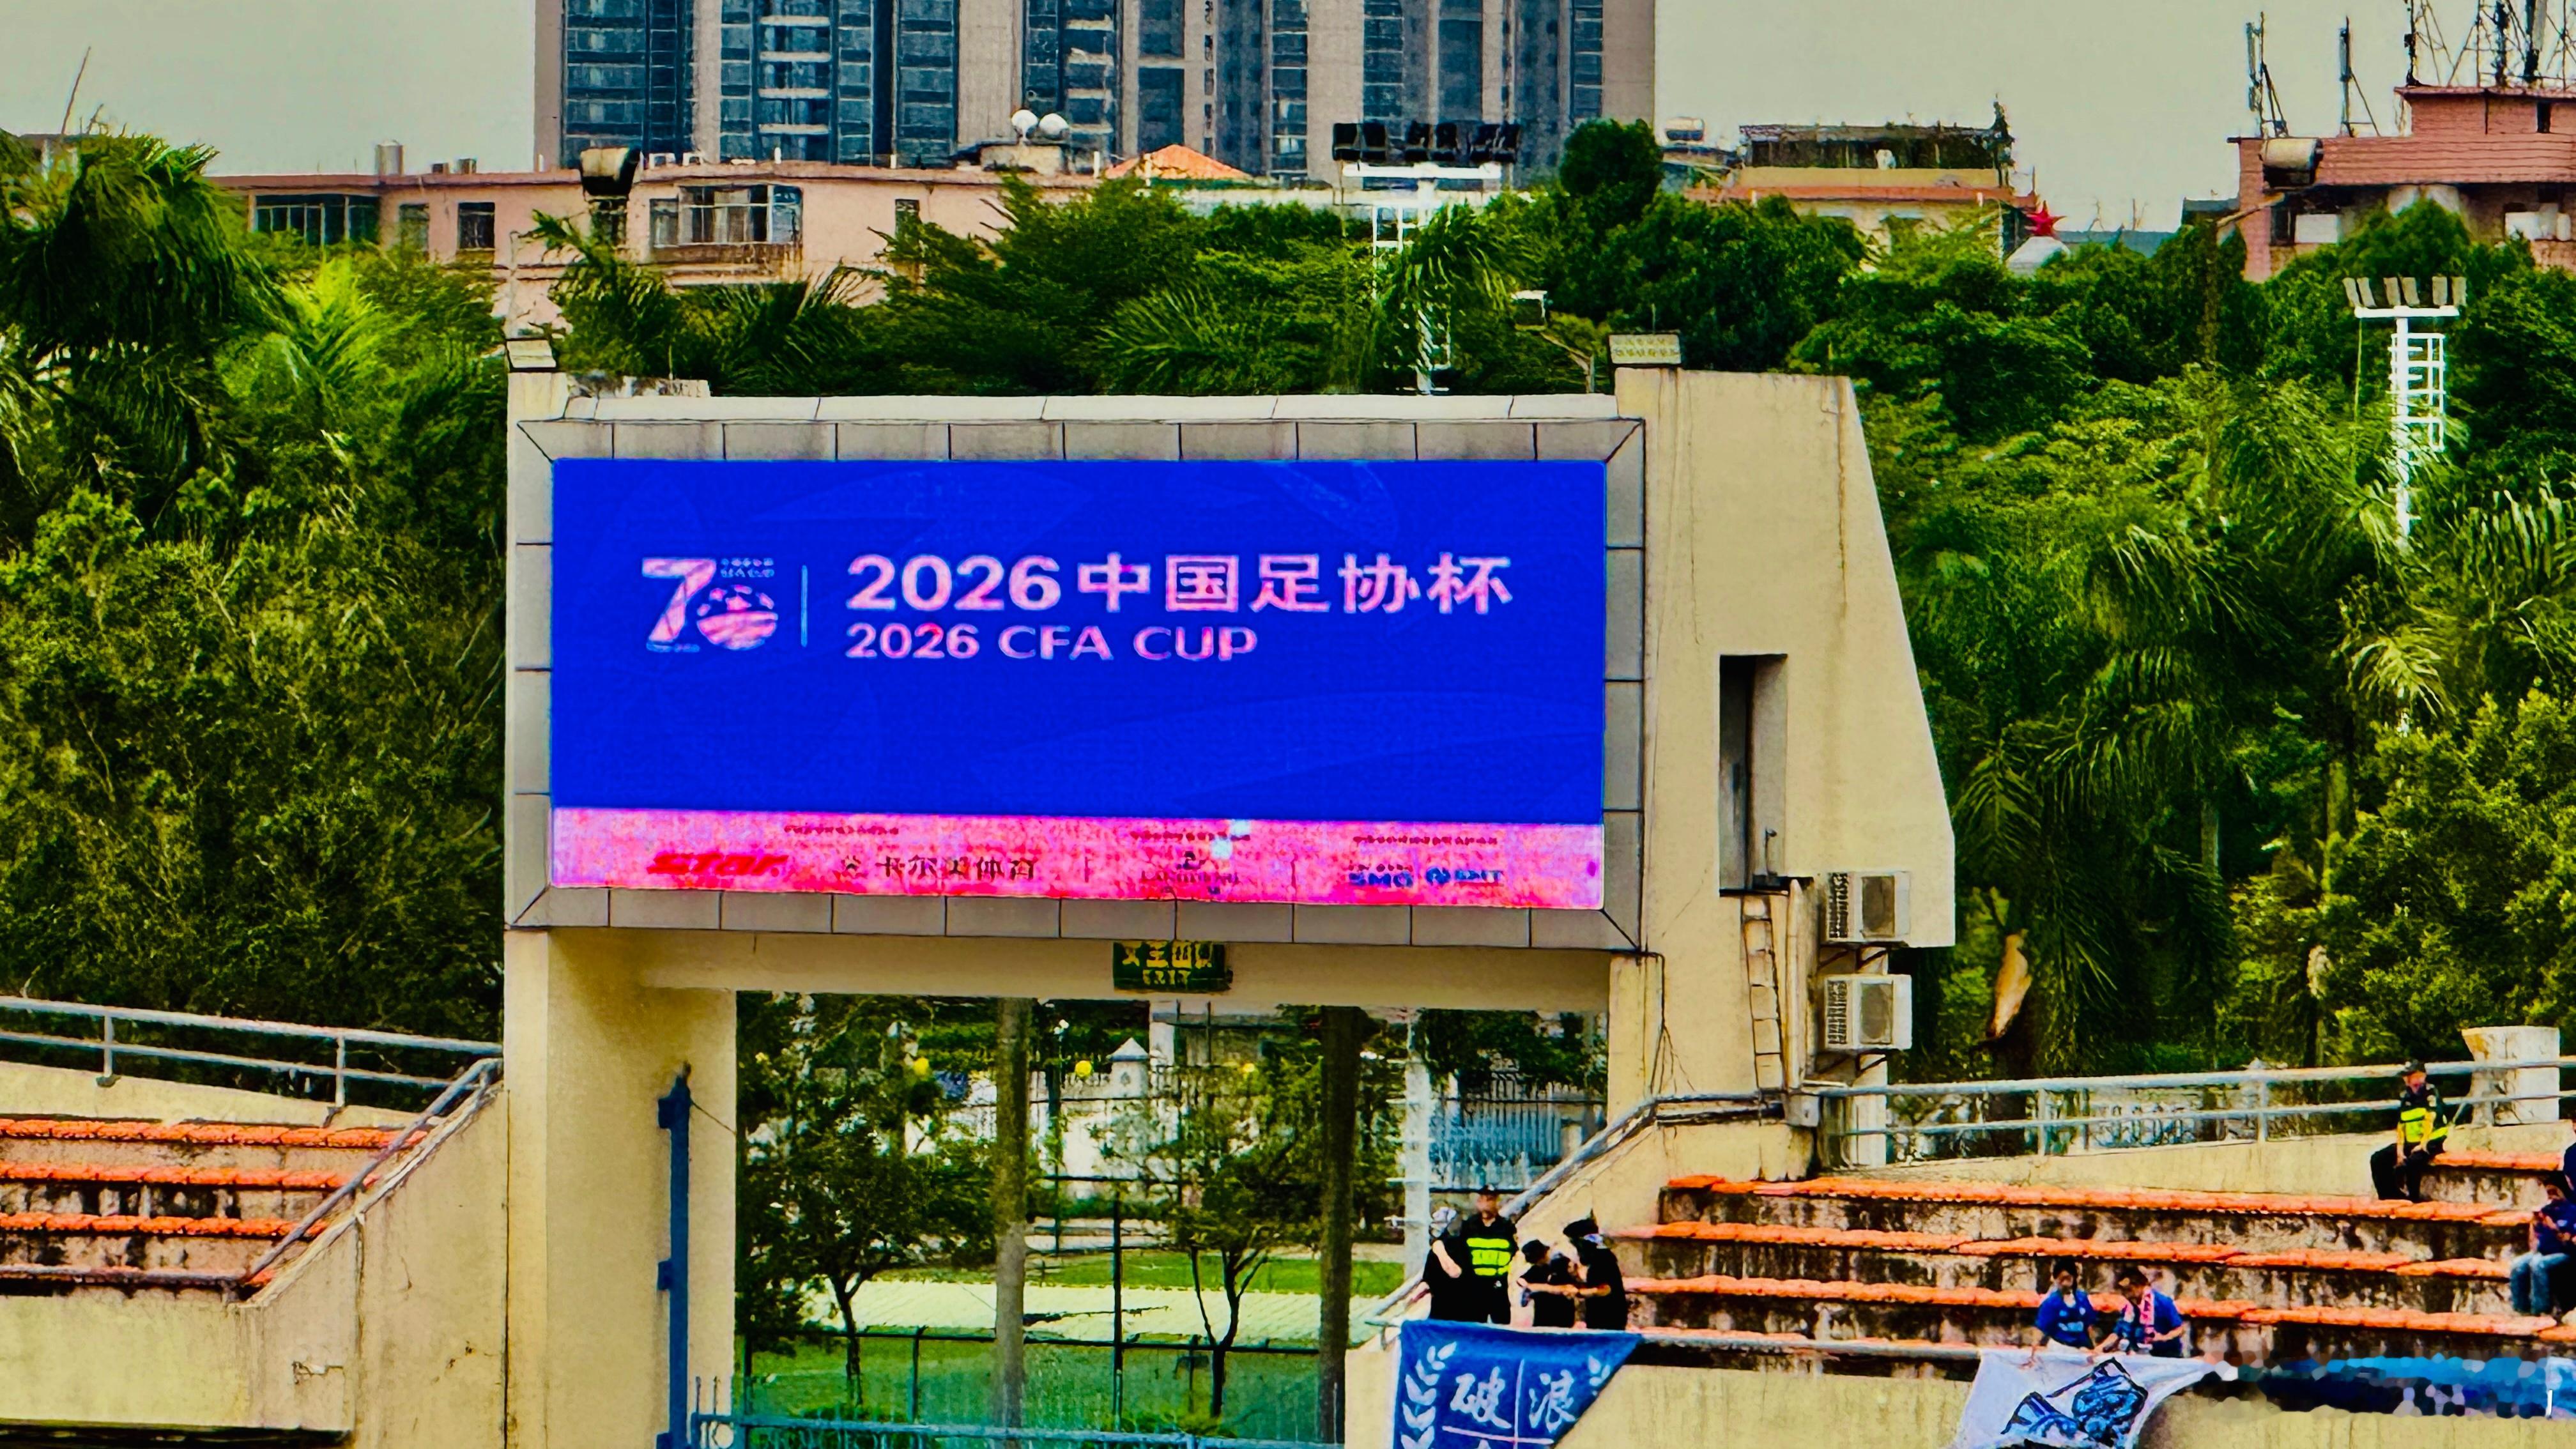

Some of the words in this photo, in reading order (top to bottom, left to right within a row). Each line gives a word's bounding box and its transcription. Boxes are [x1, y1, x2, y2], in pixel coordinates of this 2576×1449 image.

[847, 552, 1513, 614] 2026中国足协杯
[846, 623, 979, 658] 2026
[999, 626, 1113, 659] CFA
[1134, 627, 1257, 661] CUP
